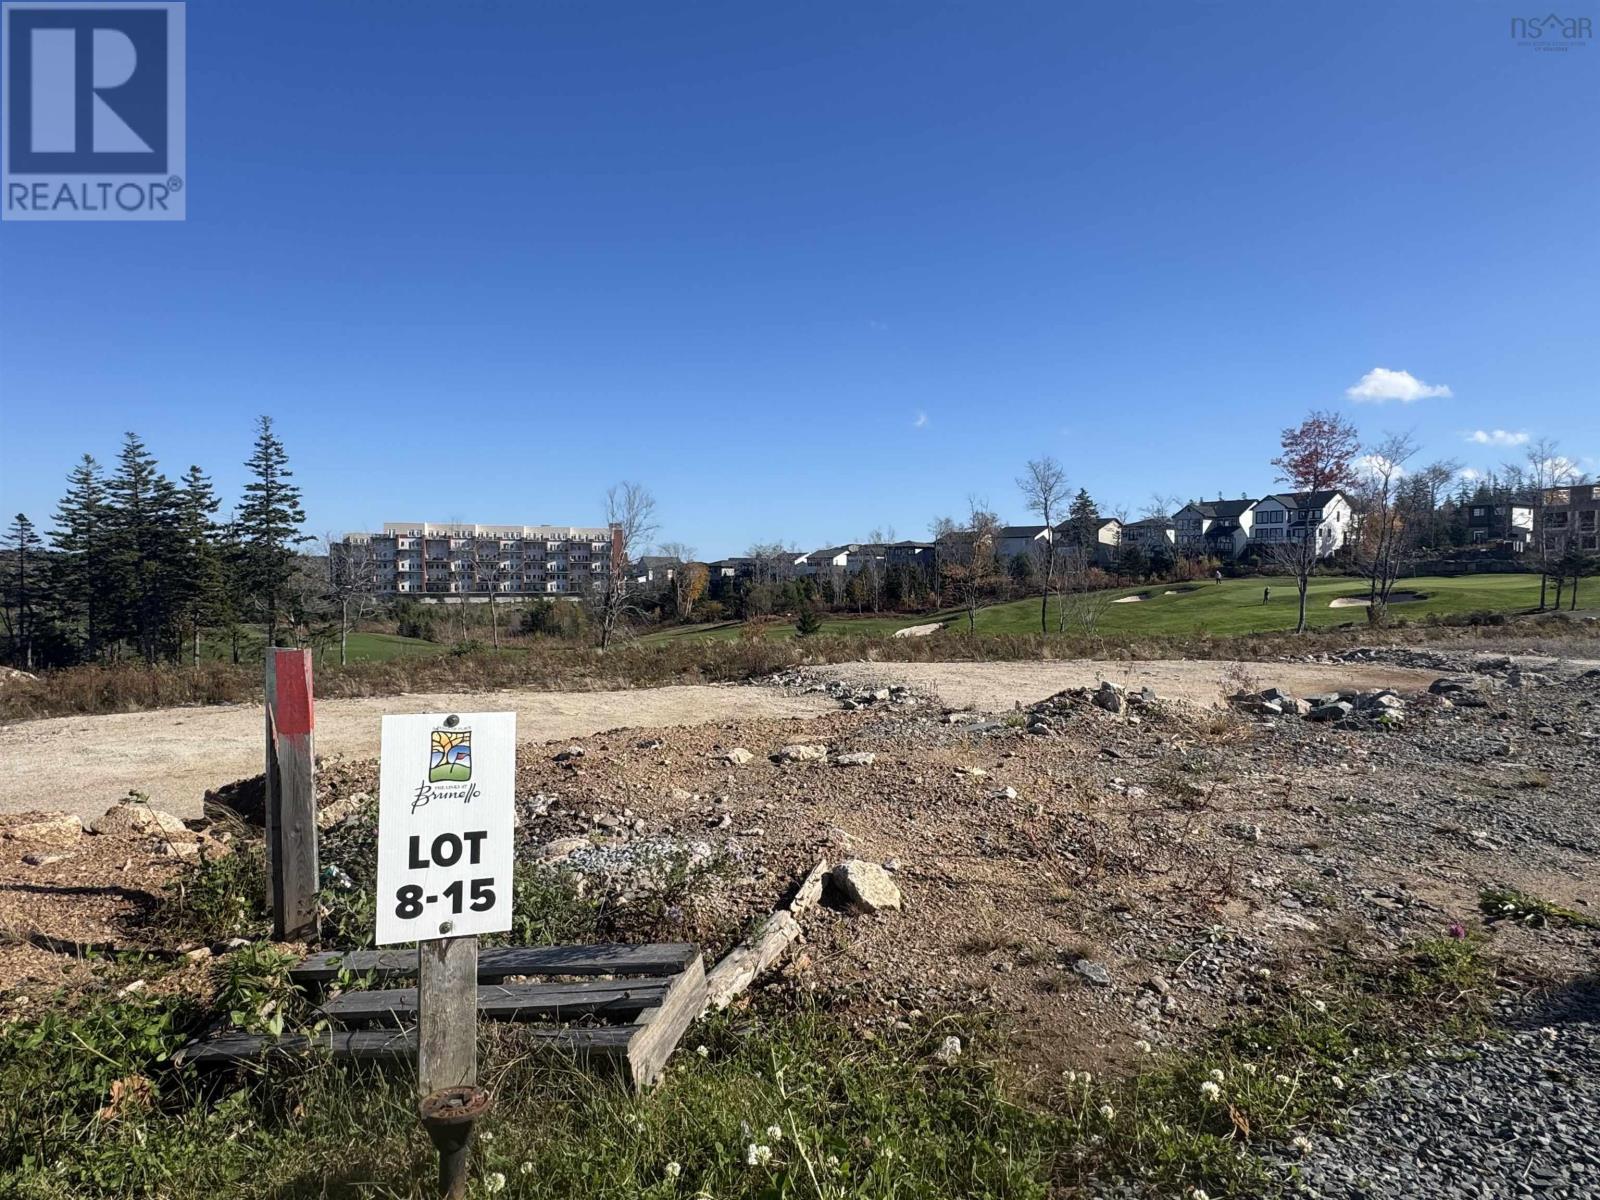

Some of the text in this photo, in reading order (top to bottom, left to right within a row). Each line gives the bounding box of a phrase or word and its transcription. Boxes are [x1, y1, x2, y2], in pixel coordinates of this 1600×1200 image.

[411, 779, 481, 815] Brunello
[408, 830, 488, 870] LOT
[395, 877, 497, 920] 8-15
